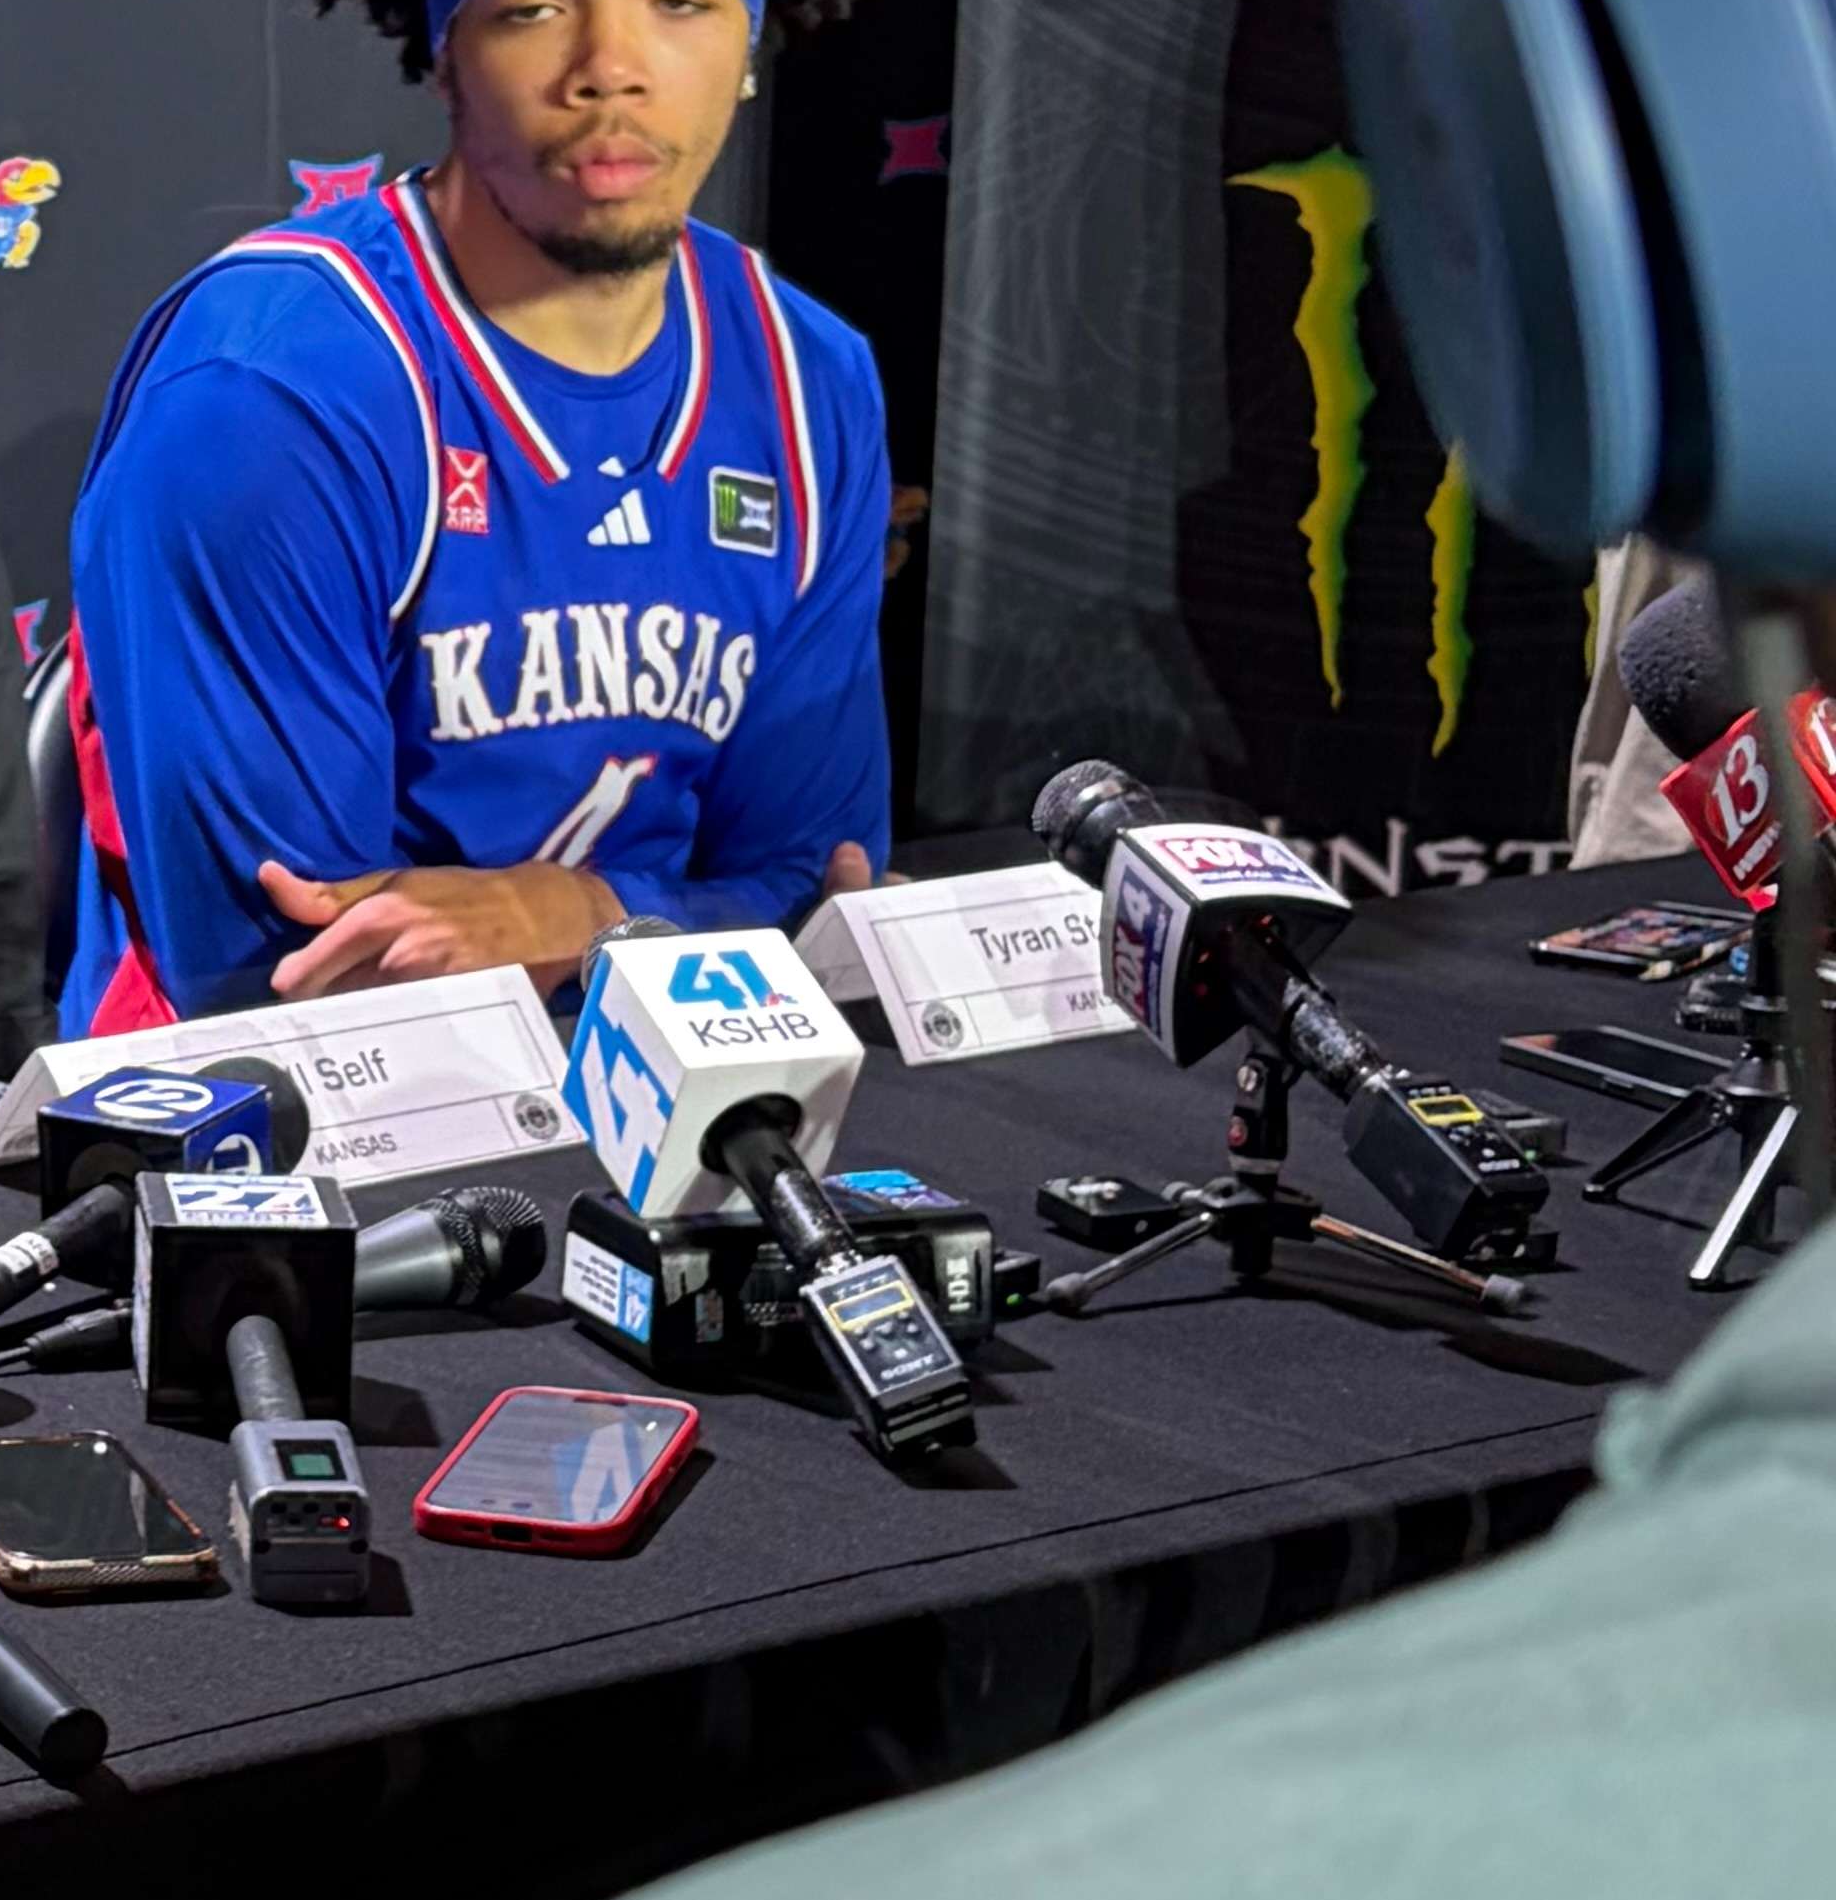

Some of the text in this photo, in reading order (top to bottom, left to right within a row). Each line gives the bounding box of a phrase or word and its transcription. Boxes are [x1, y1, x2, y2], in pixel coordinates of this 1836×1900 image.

[445, 504, 489, 531] XRP
[419, 602, 758, 743] KANSAS
[1711, 733, 1770, 850] 13
[1165, 837, 1264, 869] FOX
[969, 912, 1100, 964] Tyran St
[1114, 878, 1153, 1015] FOX 4
[667, 949, 774, 1011] 41
[687, 1011, 820, 1049] KSHB
[315, 1047, 391, 1092] Self
[315, 1131, 398, 1167] KANSAS
[172, 1185, 314, 1216] 27
